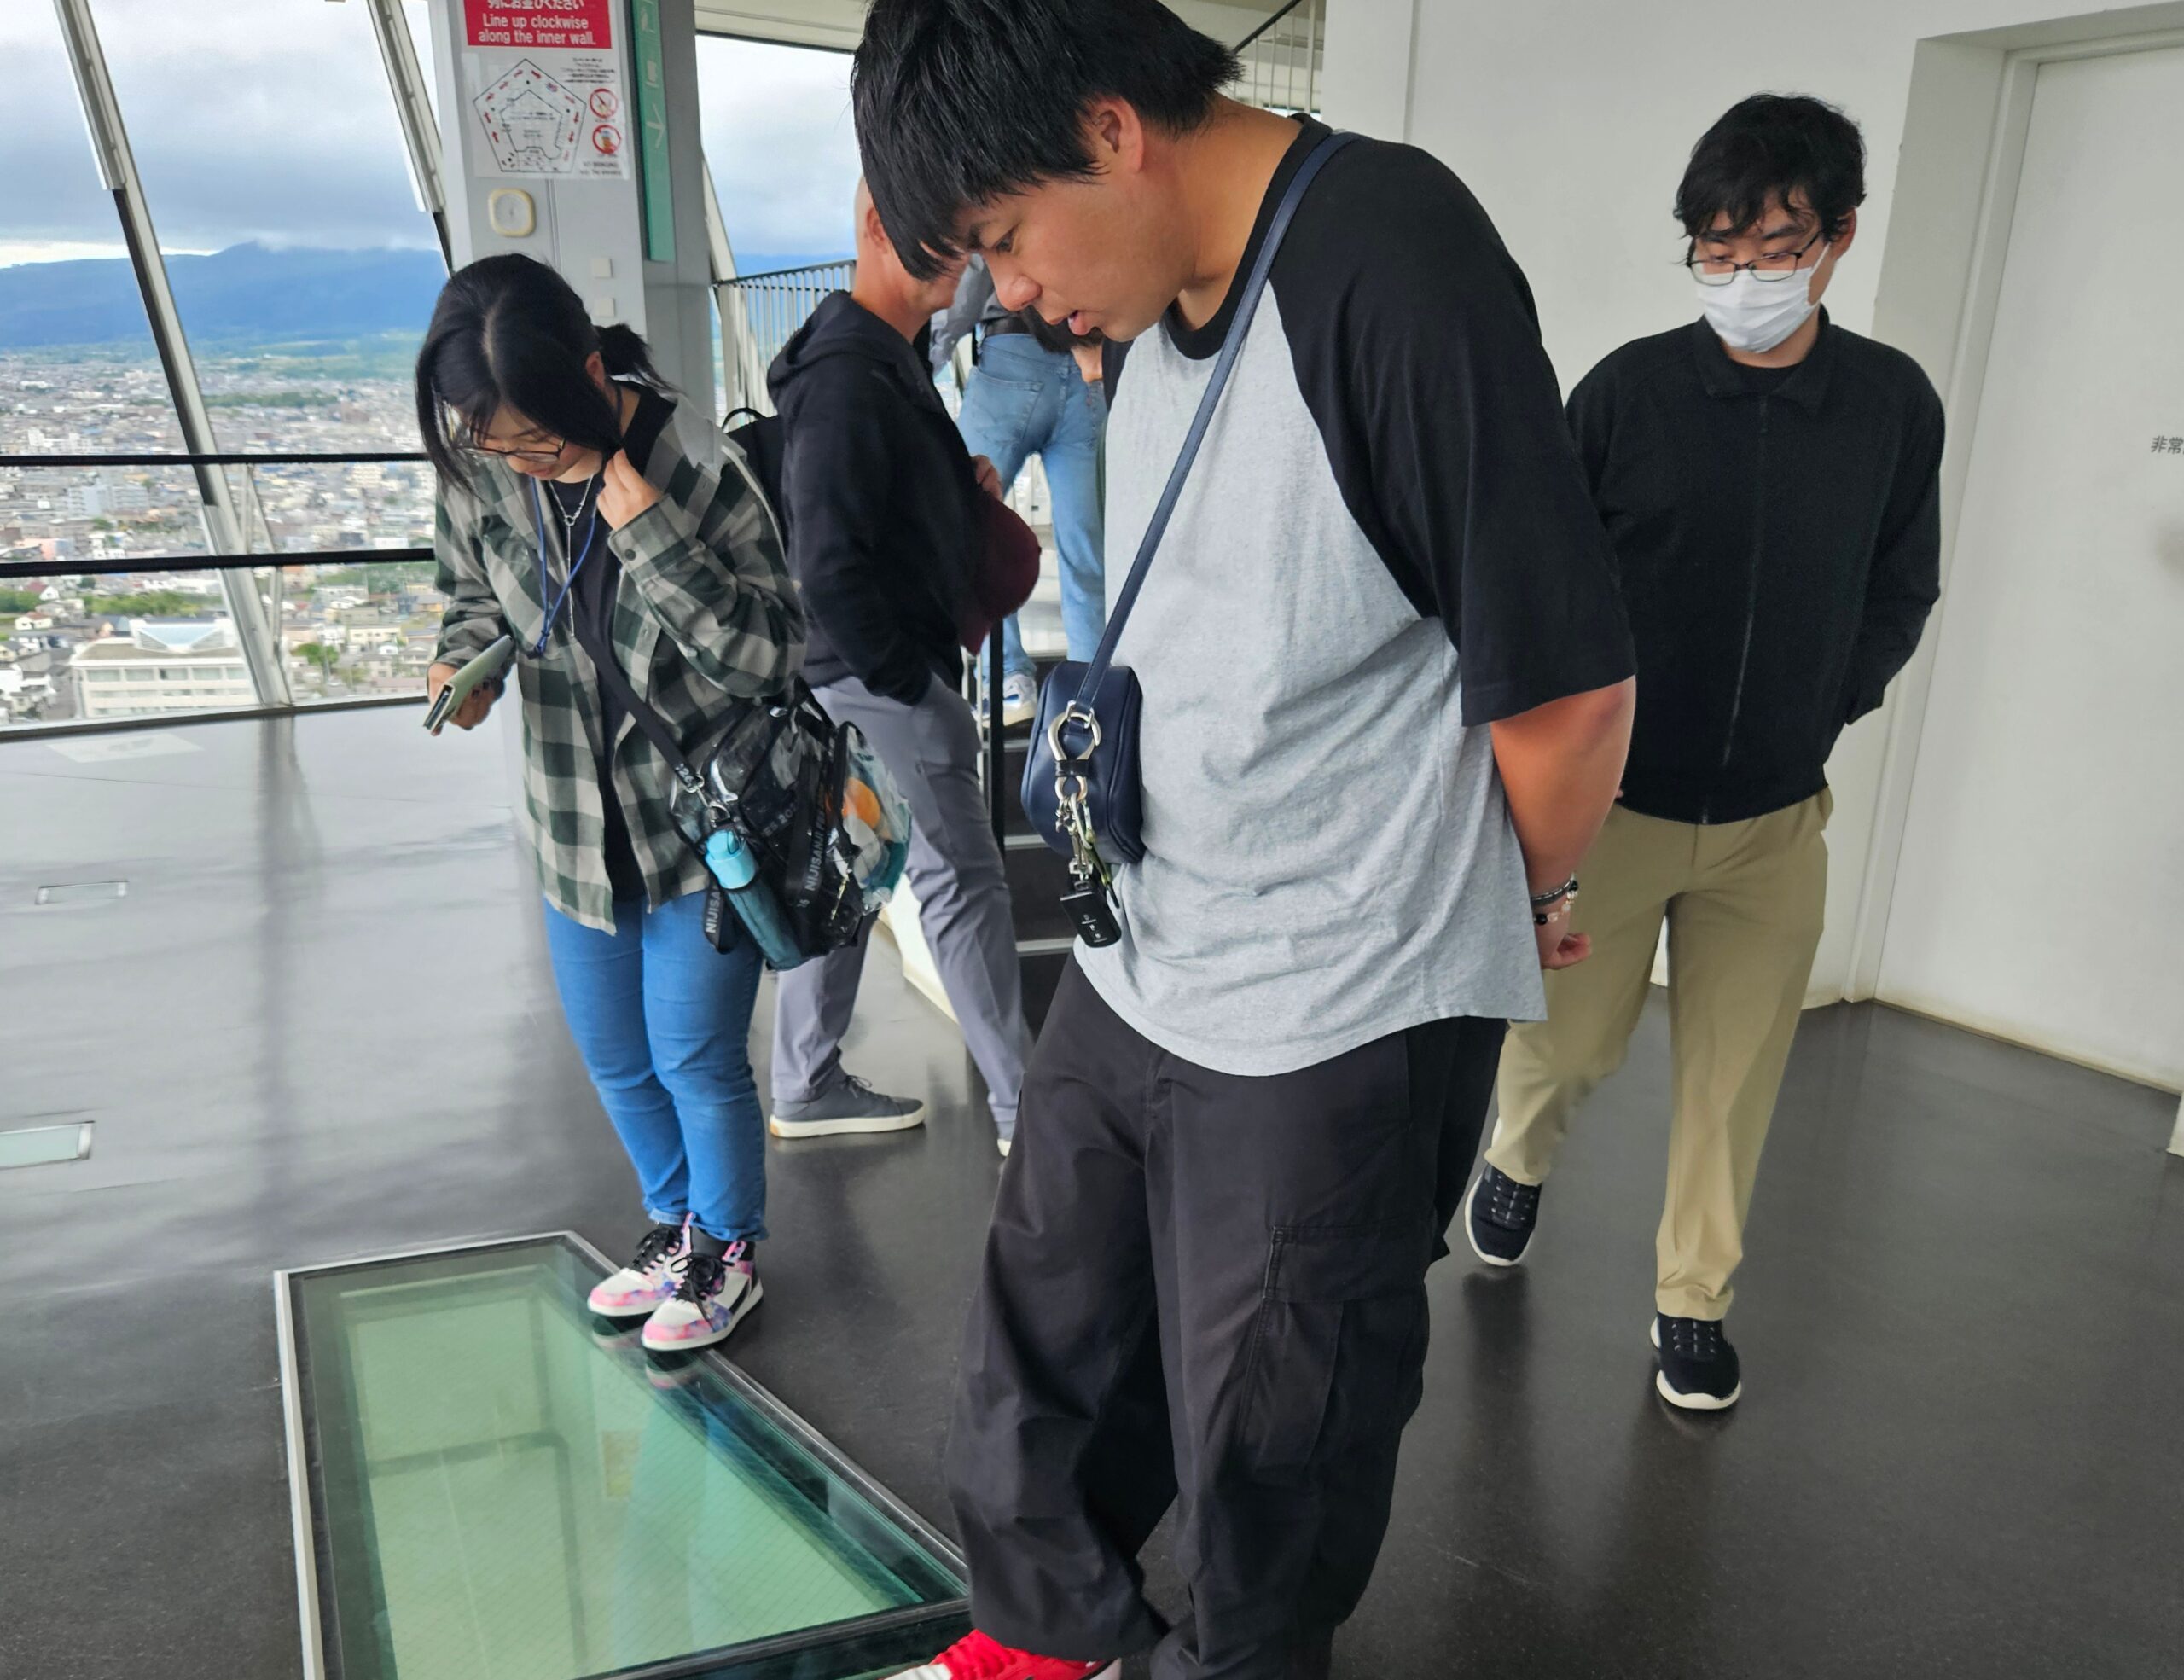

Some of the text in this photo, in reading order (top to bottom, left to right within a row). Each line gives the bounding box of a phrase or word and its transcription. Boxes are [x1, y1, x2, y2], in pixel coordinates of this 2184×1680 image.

[483, 13, 589, 29] Line up clockwise
[478, 29, 511, 44] along
[514, 30, 533, 43] the
[537, 31, 566, 44] inner
[2151, 436, 2184, 454] 非常
[804, 831, 825, 891] NIJISANJI
[706, 887, 721, 933] NIJISA
